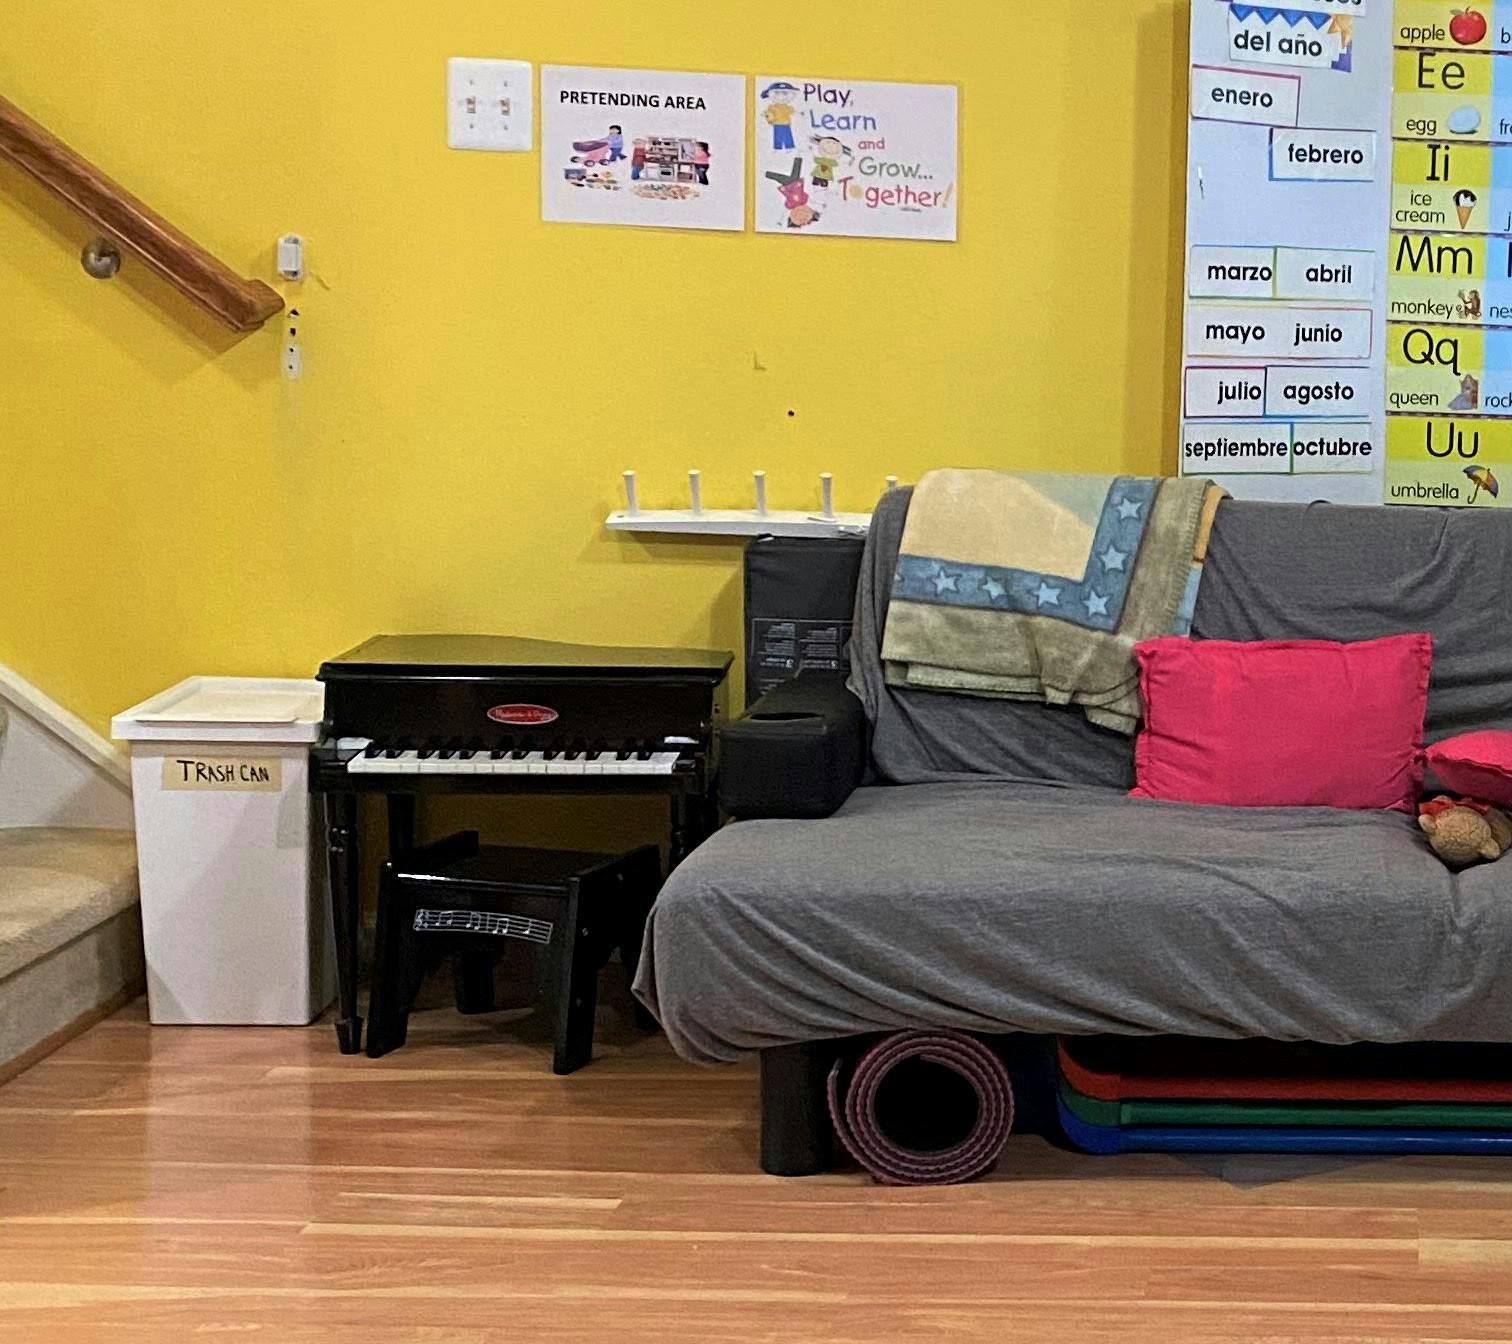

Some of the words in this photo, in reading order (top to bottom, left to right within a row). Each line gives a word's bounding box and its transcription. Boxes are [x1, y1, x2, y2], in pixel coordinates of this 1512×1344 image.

[1234, 30, 1271, 52] del
[1278, 33, 1322, 57] año
[1400, 24, 1446, 43] apple
[1418, 53, 1465, 90] Ee
[560, 90, 661, 107] PRETENDING
[664, 96, 706, 110] AREA
[804, 83, 854, 107] Play,
[1211, 87, 1273, 107] enero
[810, 109, 876, 131] Learn
[1406, 119, 1437, 136] egg
[858, 138, 885, 150] and
[1287, 144, 1364, 164] febrero
[858, 156, 933, 180] Grow...
[1426, 144, 1450, 182] Ii
[838, 176, 953, 208] Together!
[1410, 190, 1432, 206] ice
[1396, 209, 1445, 223] cream
[1395, 235, 1473, 274] Mm
[1207, 264, 1272, 281] marzo
[1305, 263, 1352, 283] abril
[1391, 299, 1452, 319] monkey
[1206, 323, 1265, 345] mayo
[1294, 323, 1343, 346] junio
[1403, 328, 1461, 376] Qq
[1217, 381, 1262, 404] julio
[1283, 381, 1354, 405] agosto
[1390, 391, 1439, 408] queen
[1185, 437, 1288, 461] septiembre
[1293, 437, 1372, 456] octubre
[1427, 421, 1478, 458] Uu
[1391, 482, 1459, 499] umbrella
[177, 759, 234, 782] TRASH
[240, 764, 269, 782] CAN
